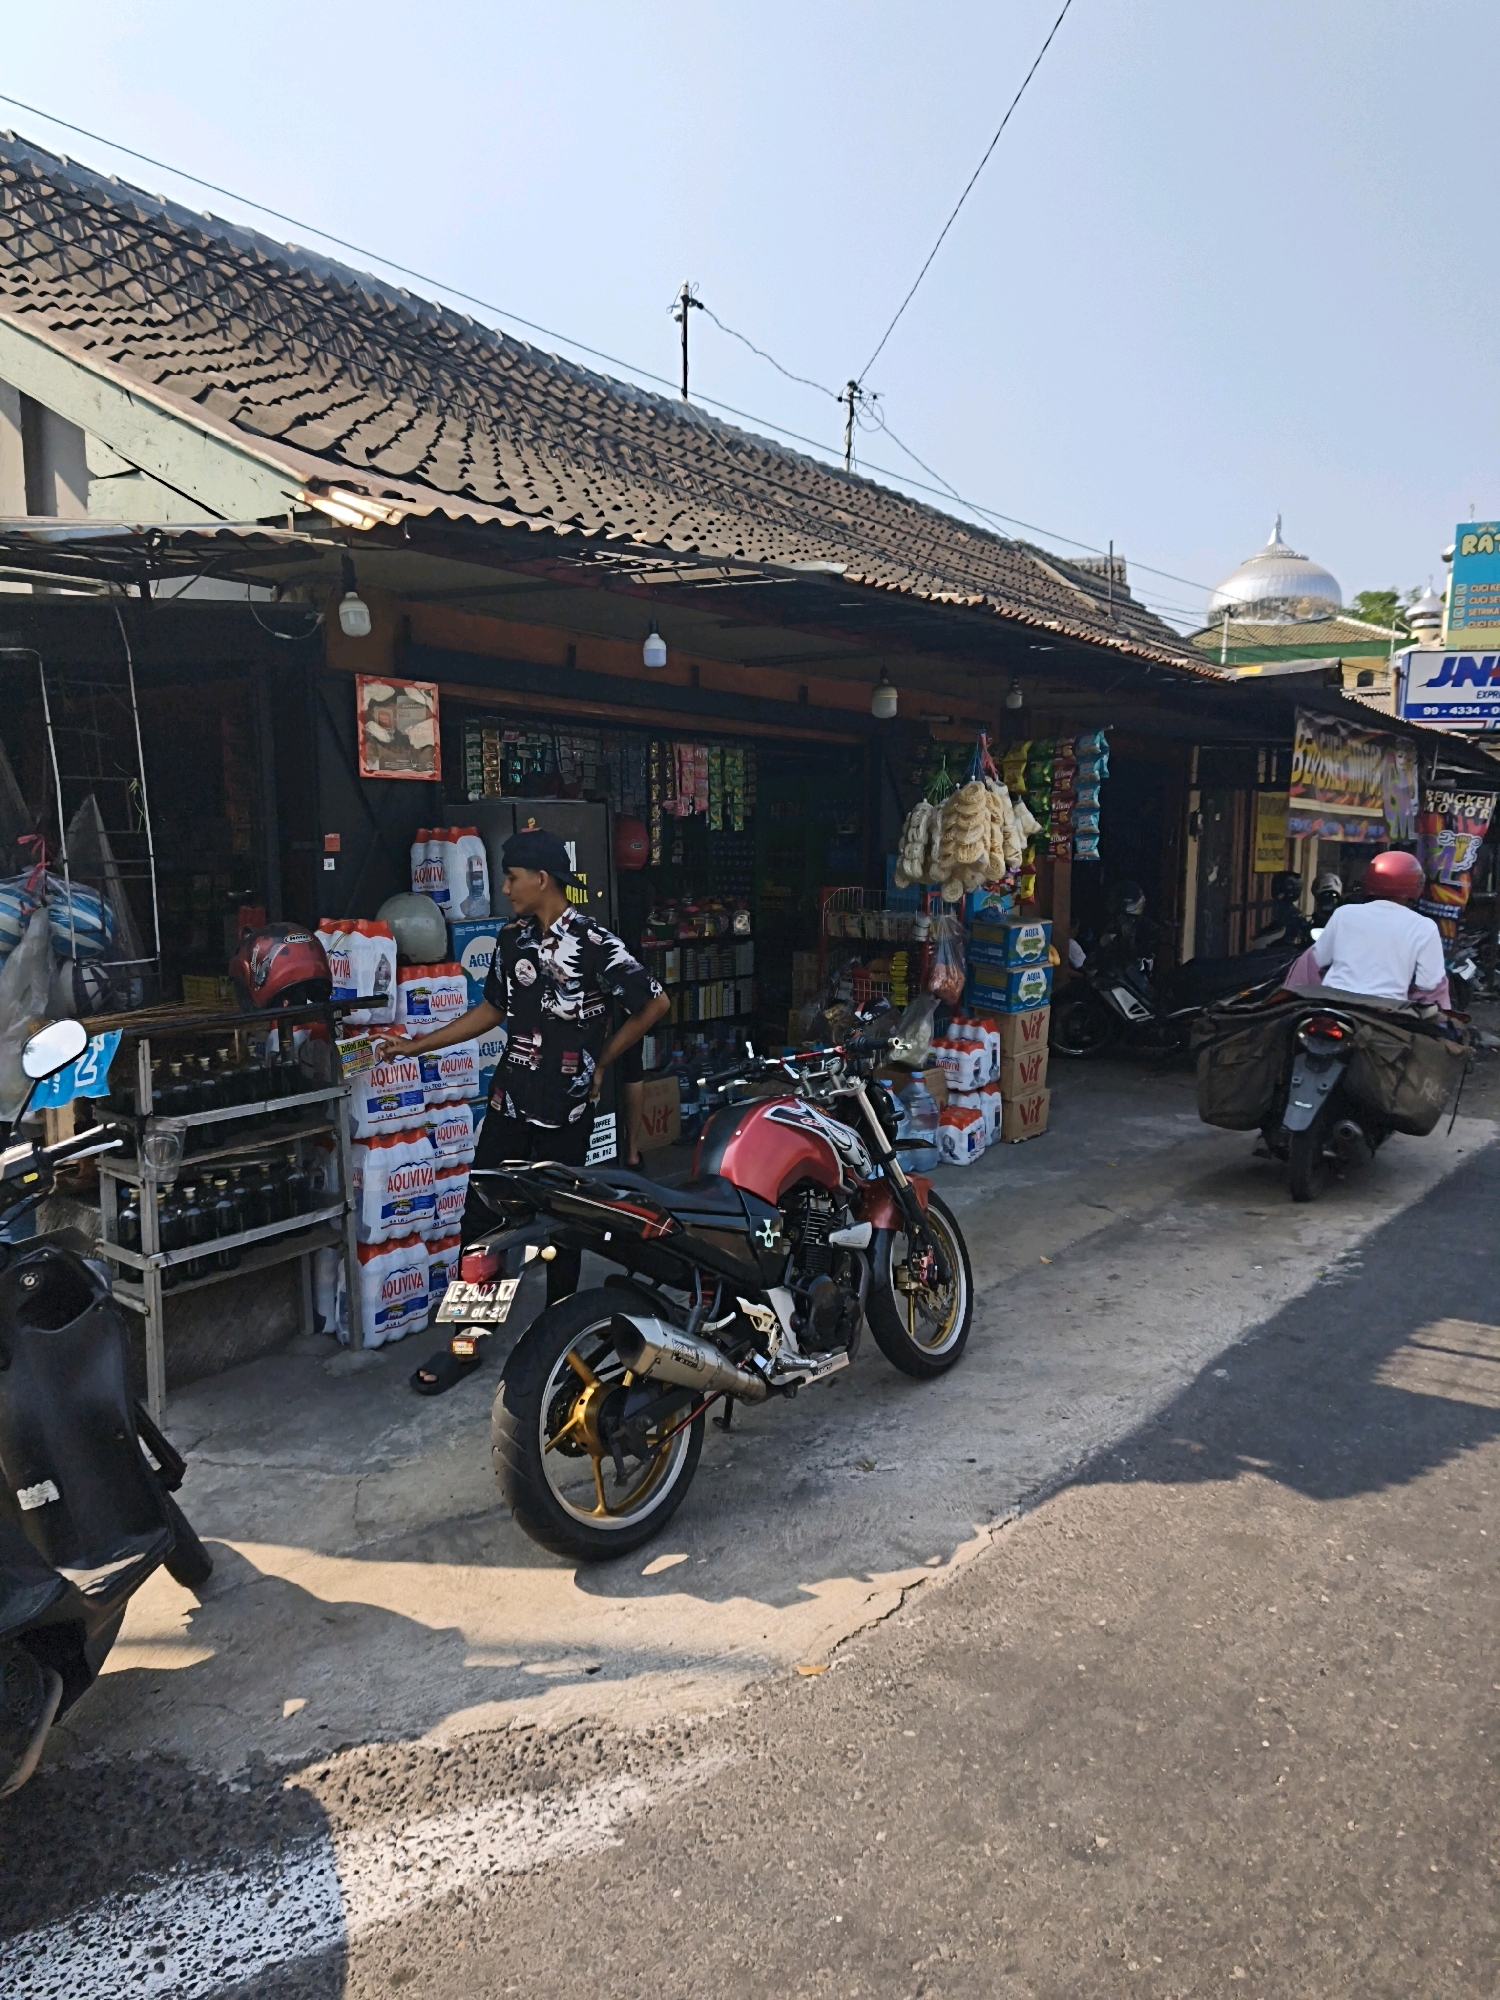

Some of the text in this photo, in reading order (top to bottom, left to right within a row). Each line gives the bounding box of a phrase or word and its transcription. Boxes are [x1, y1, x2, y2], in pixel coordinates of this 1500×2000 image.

[1468, 608, 1499, 617] SETRIKA
[1423, 706, 1439, 715] 99
[1449, 706, 1480, 715] 4334
[1491, 706, 1500, 715] 0
[1425, 789, 1497, 809] BENGKEL
[468, 952, 493, 968] AQU
[430, 993, 464, 1008] AQUVIVA
[1020, 1011, 1045, 1042] Vit
[370, 1062, 419, 1088] AQUVIVA
[440, 1056, 474, 1074] AQUVIVA
[1019, 1053, 1044, 1084] Vit
[641, 1103, 674, 1136] Vit
[1019, 1095, 1045, 1127] Vit
[437, 1123, 469, 1141] AQUVIVA
[387, 1167, 434, 1194] AQUVIVA
[381, 1272, 424, 1301] AQUVIVA
[444, 1282, 516, 1302] AE 2902 KZ
